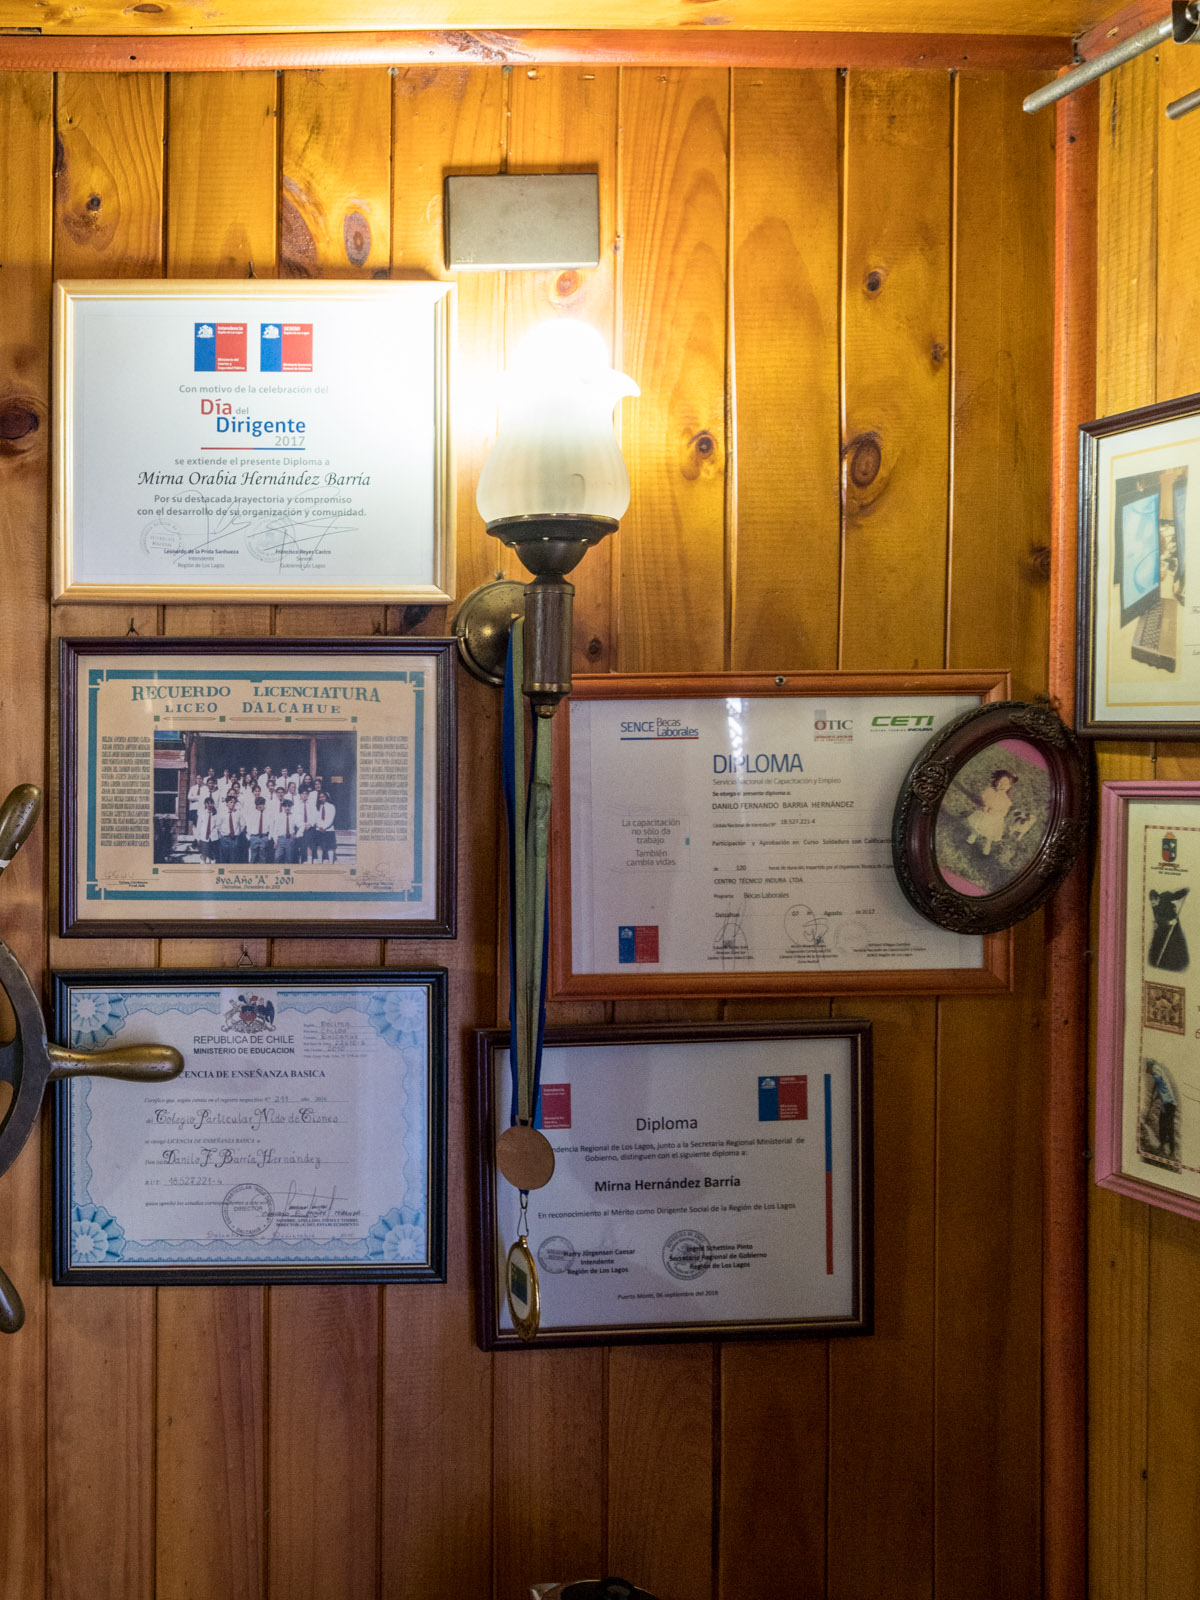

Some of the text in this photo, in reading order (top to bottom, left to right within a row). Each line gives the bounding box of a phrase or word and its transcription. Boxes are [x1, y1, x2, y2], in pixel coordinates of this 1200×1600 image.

[180, 385, 328, 394] Con motivo de la celebración del
[201, 399, 249, 415] Día del
[217, 417, 306, 437] Dirigente
[275, 436, 305, 447] 2017
[241, 458, 281, 467] presente
[284, 458, 321, 467] Diploma
[138, 471, 370, 486] Mirna Orabia Hernández Barría
[155, 495, 169, 503] Por
[185, 495, 232, 503] destacada
[235, 496, 284, 504] trayectoria
[295, 496, 351, 505] compromiso
[243, 508, 302, 518] organización
[312, 508, 366, 517] comunidad.
[132, 686, 380, 702] RECUERDO LICENCIATURA
[165, 702, 340, 714] LICEO DALCAHUE
[621, 718, 681, 732] SENCE Becas
[814, 716, 935, 730] OTIC CETI
[657, 727, 699, 736] Laborales
[714, 753, 803, 773] DIPLOMA
[774, 777, 813, 785] Capacitación
[633, 818, 680, 827] capacitación
[637, 837, 664, 845] trabajo
[626, 859, 654, 867] cambia
[194, 1035, 294, 1044] REPUBLICA DE CHILE
[232, 1069, 288, 1078] ENSEÑANZA
[291, 1070, 325, 1078] BASICA
[155, 1109, 195, 1130] Colegio
[194, 1109, 252, 1130] Particular
[637, 1117, 697, 1133] Diploma
[580, 1145, 609, 1153] Regional
[162, 1149, 200, 1164] Danilo
[257, 1149, 321, 1169] Hernández
[585, 1154, 618, 1162] Gobierno,
[680, 1151, 710, 1159] siguiente
[712, 1150, 739, 1158] diploma
[595, 1176, 740, 1192] Mirna Hernández Barría
[548, 1211, 601, 1219] reconocimiento
[657, 1207, 687, 1215] Dirigente
[729, 1204, 752, 1212] Región
